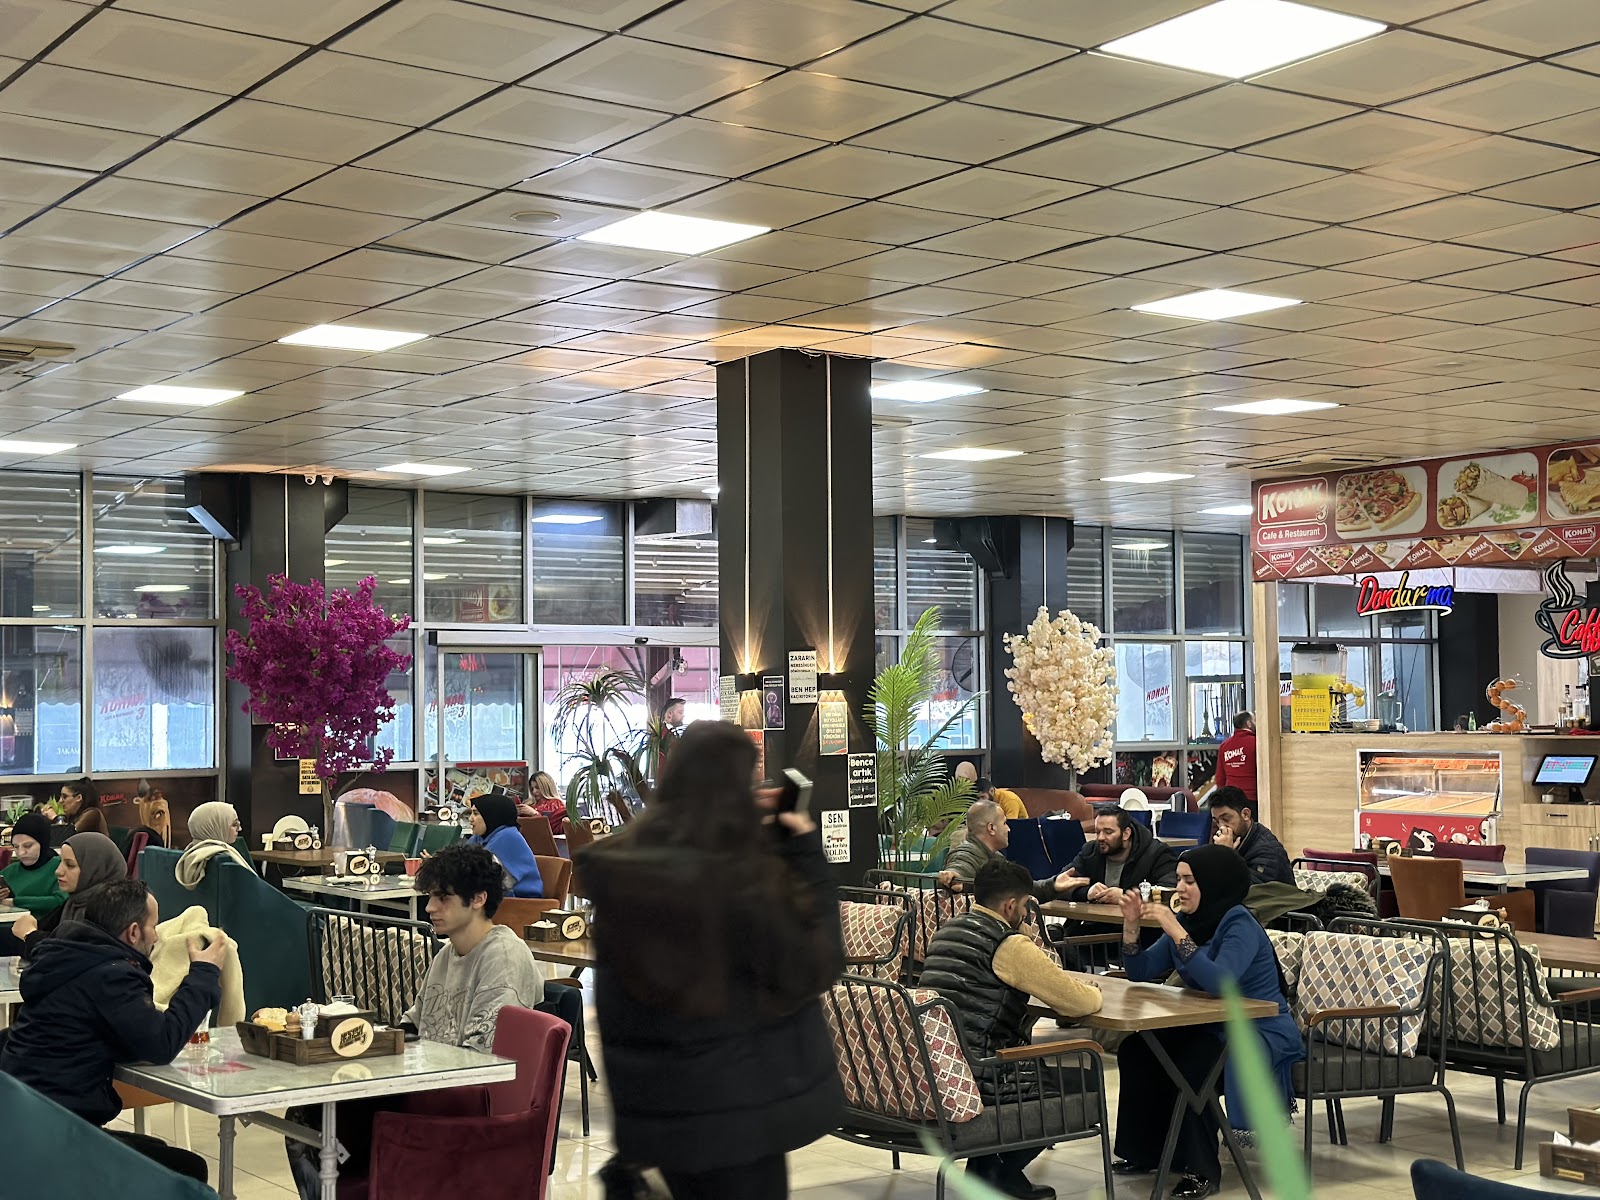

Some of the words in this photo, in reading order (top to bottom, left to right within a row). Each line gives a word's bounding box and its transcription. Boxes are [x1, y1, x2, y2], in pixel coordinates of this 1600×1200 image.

[1262, 483, 1323, 520] KONAK
[1317, 503, 1328, 521] 3
[1262, 531, 1277, 541] Cafe
[1278, 530, 1284, 539] &
[1284, 527, 1321, 539] Restaurant
[1565, 527, 1593, 538] KONAK
[1466, 541, 1489, 558] KONAK
[1531, 537, 1556, 554] KONAK
[1271, 551, 1293, 562] KONAK
[1350, 551, 1371, 567] KONAK
[1406, 546, 1428, 562] KONAK
[1295, 557, 1315, 573] KONAK
[1357, 572, 1453, 614] Dondurma
[1146, 685, 1170, 702] KONAK
[1224, 746, 1244, 762] KONAK
[850, 758, 874, 767] Bence
[827, 813, 844, 823] SEN
